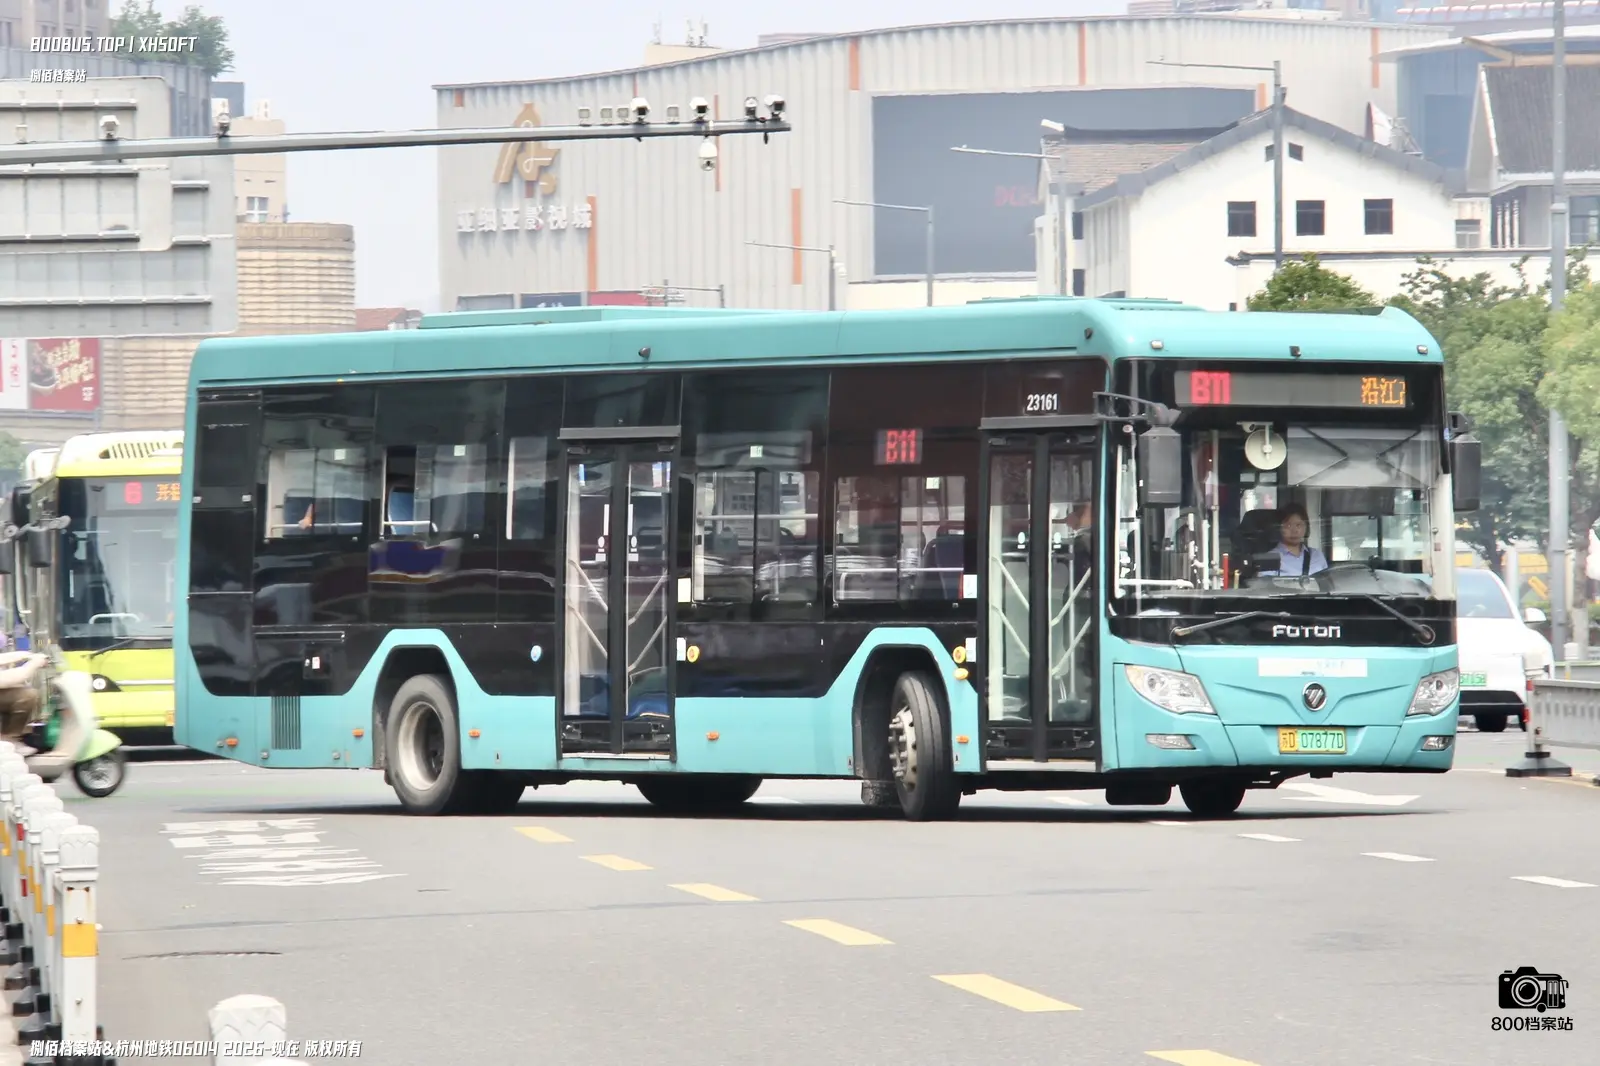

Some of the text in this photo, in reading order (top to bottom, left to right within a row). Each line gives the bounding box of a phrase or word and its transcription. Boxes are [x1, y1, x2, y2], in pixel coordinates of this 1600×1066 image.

[1190, 371, 1231, 405] B11
[1026, 393, 1058, 412] 23161
[885, 429, 916, 464] B11
[1272, 624, 1341, 638] FOTON
